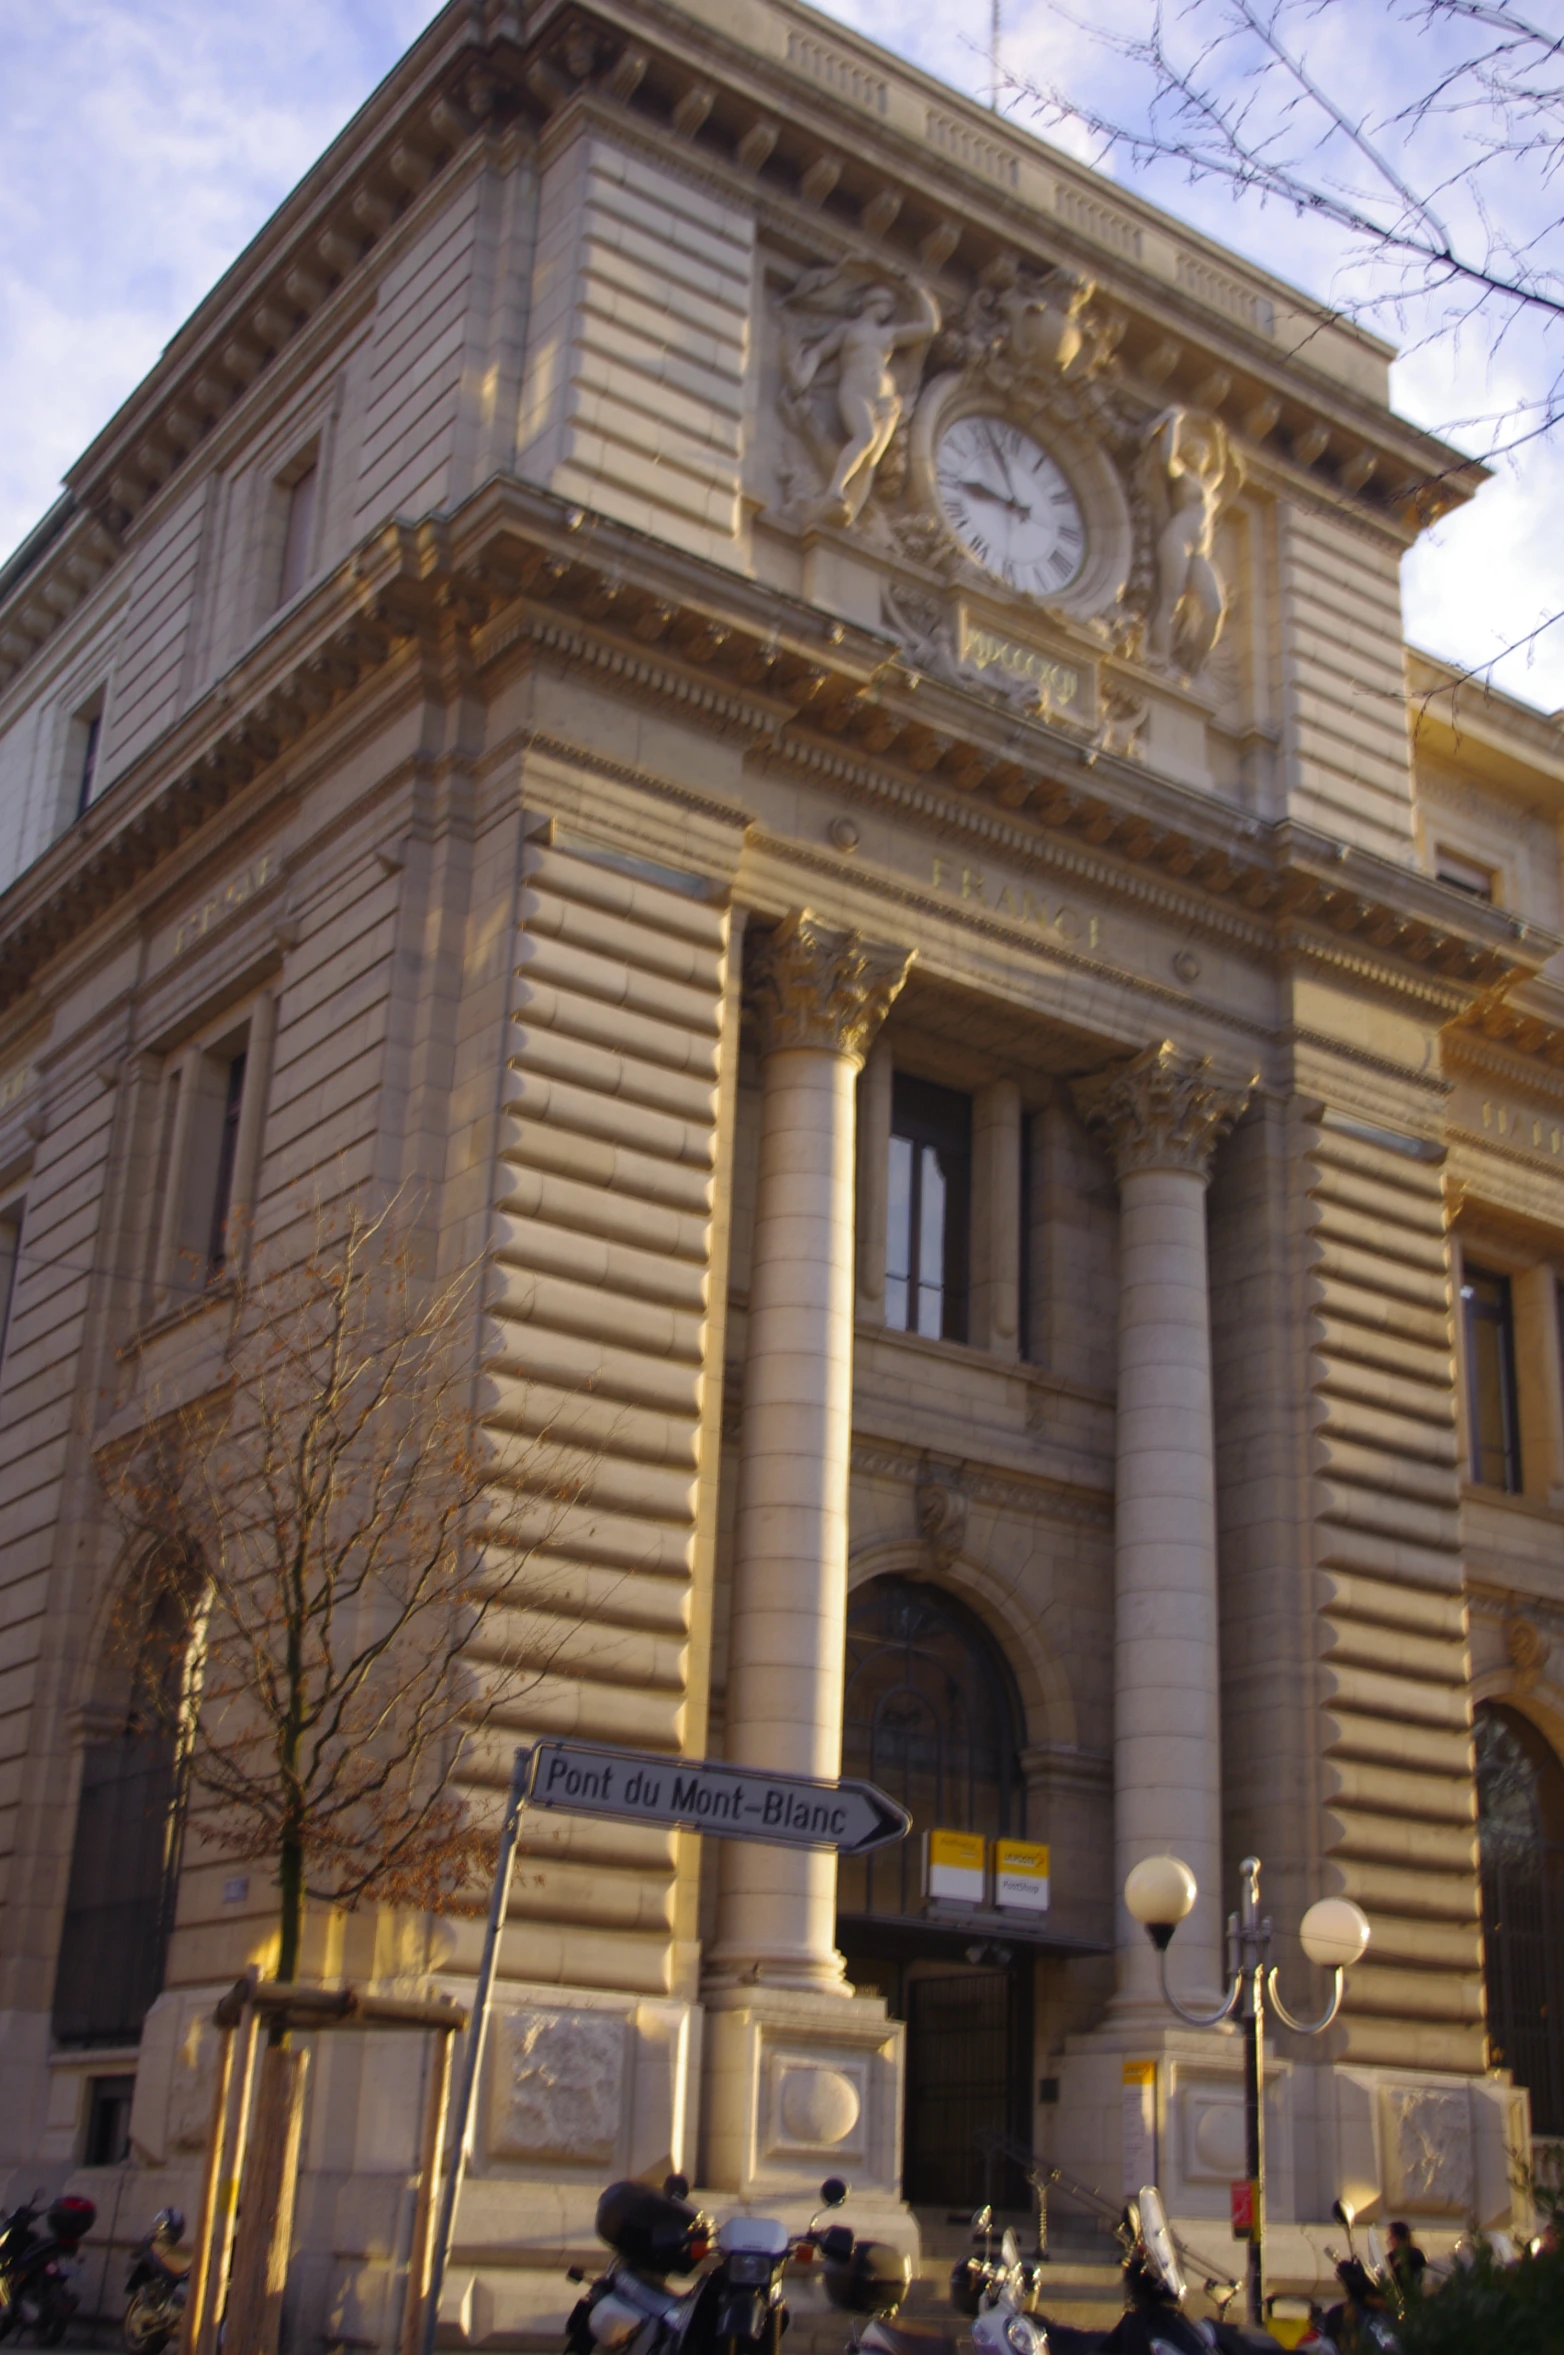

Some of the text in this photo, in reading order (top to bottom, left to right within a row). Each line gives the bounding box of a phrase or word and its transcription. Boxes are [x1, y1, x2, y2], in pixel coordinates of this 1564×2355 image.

[931, 857, 1110, 950] FRANCE
[545, 1756, 846, 1834] Pont du Mont-Blanc
